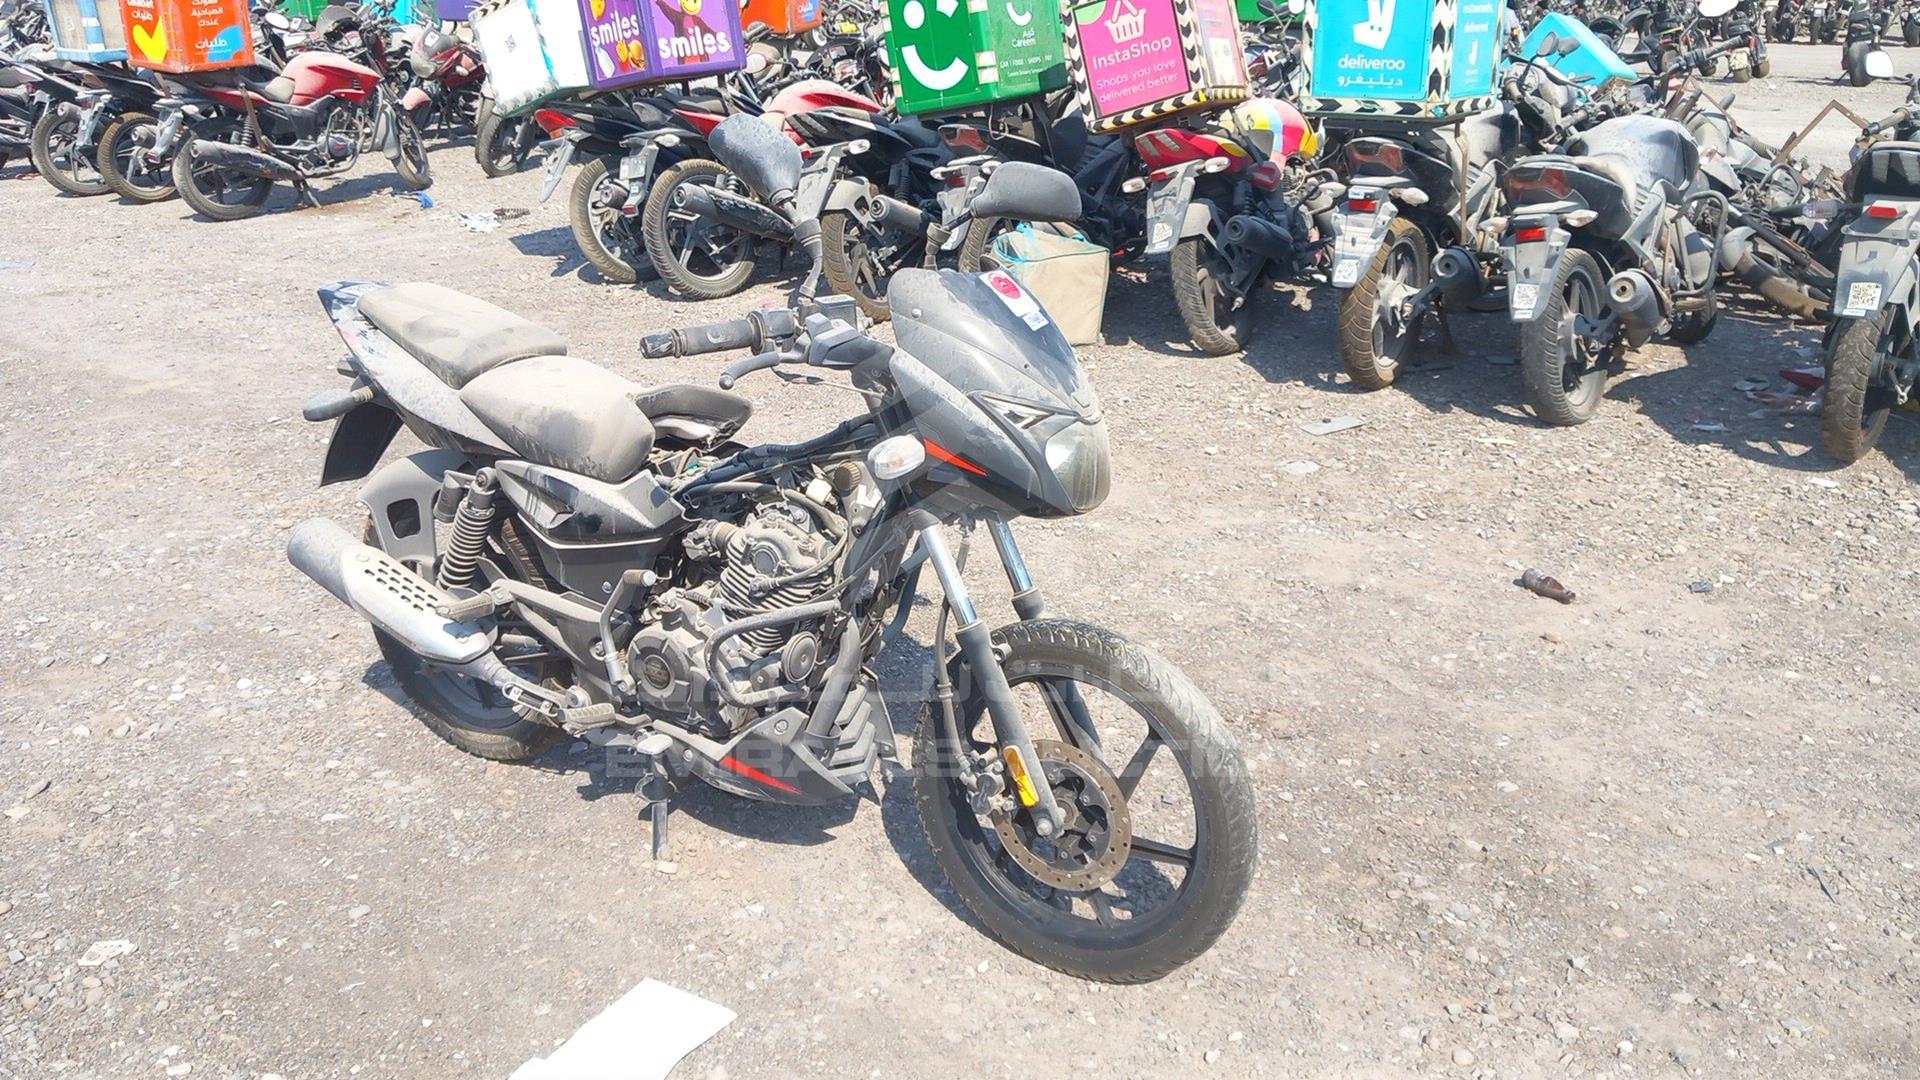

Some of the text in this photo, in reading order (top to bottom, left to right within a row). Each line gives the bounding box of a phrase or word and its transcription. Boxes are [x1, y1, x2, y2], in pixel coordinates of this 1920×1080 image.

[590, 10, 640, 47] smiles
[658, 25, 732, 59] smiles
[1092, 36, 1172, 70] InstaShop
[1338, 54, 1406, 71] deliveroo
[1096, 59, 1176, 90] Shops you love
[1100, 73, 1178, 103] delivered better
